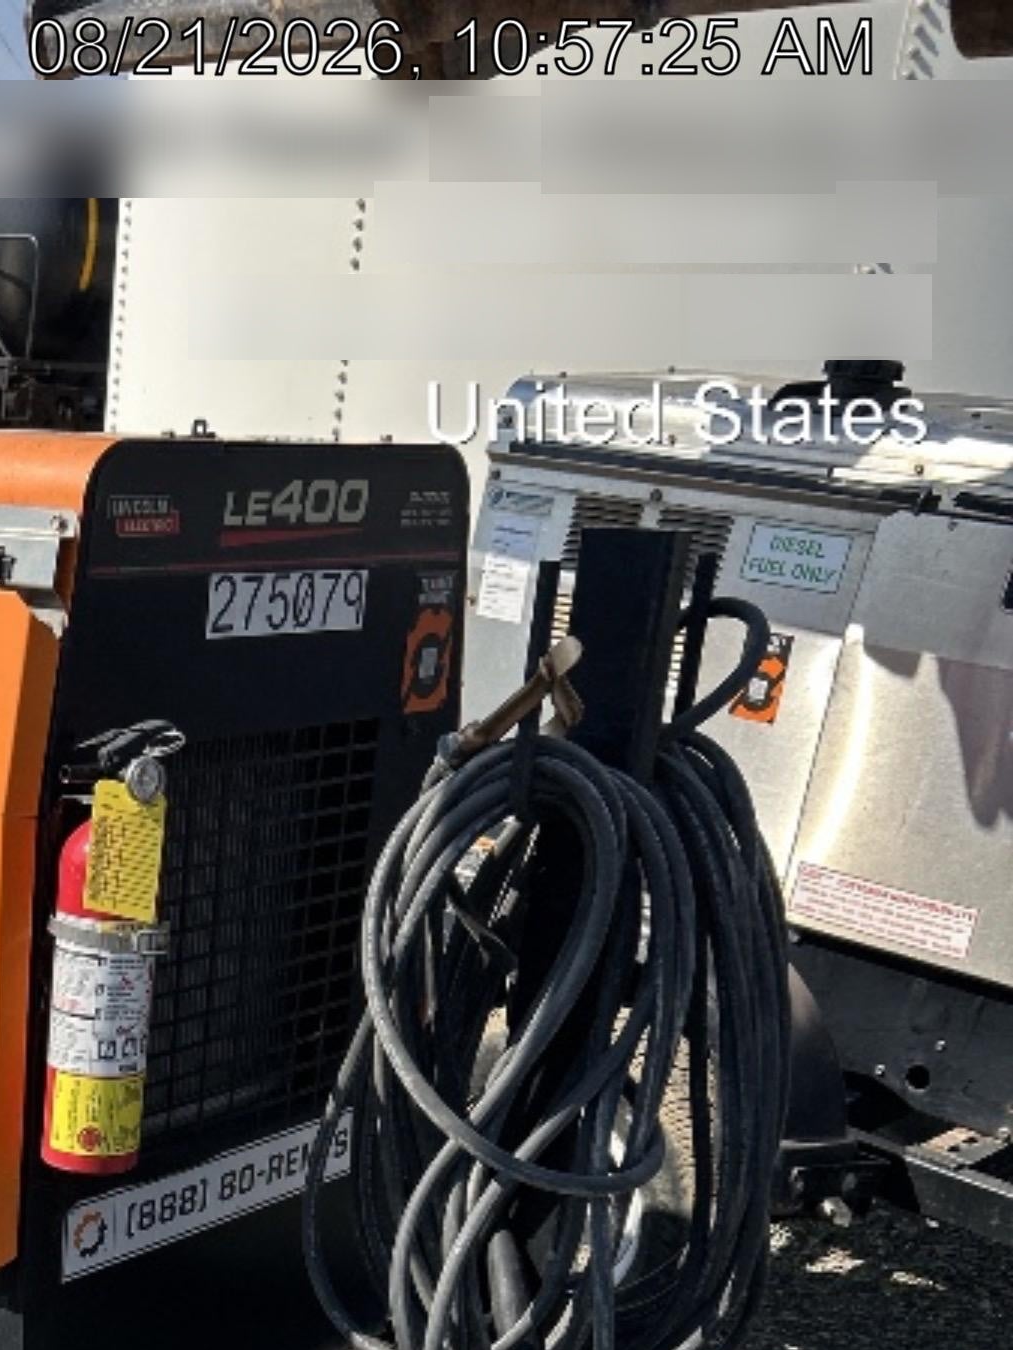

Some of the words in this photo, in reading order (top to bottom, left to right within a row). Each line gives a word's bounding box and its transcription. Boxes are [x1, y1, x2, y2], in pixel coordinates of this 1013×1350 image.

[222, 479, 369, 526] LE400
[770, 535, 826, 559] DIESEL
[749, 558, 787, 577] FUEL
[791, 564, 836, 584] ONLY
[210, 571, 365, 633] 275079
[218, 1127, 348, 1201] 80-RENS
